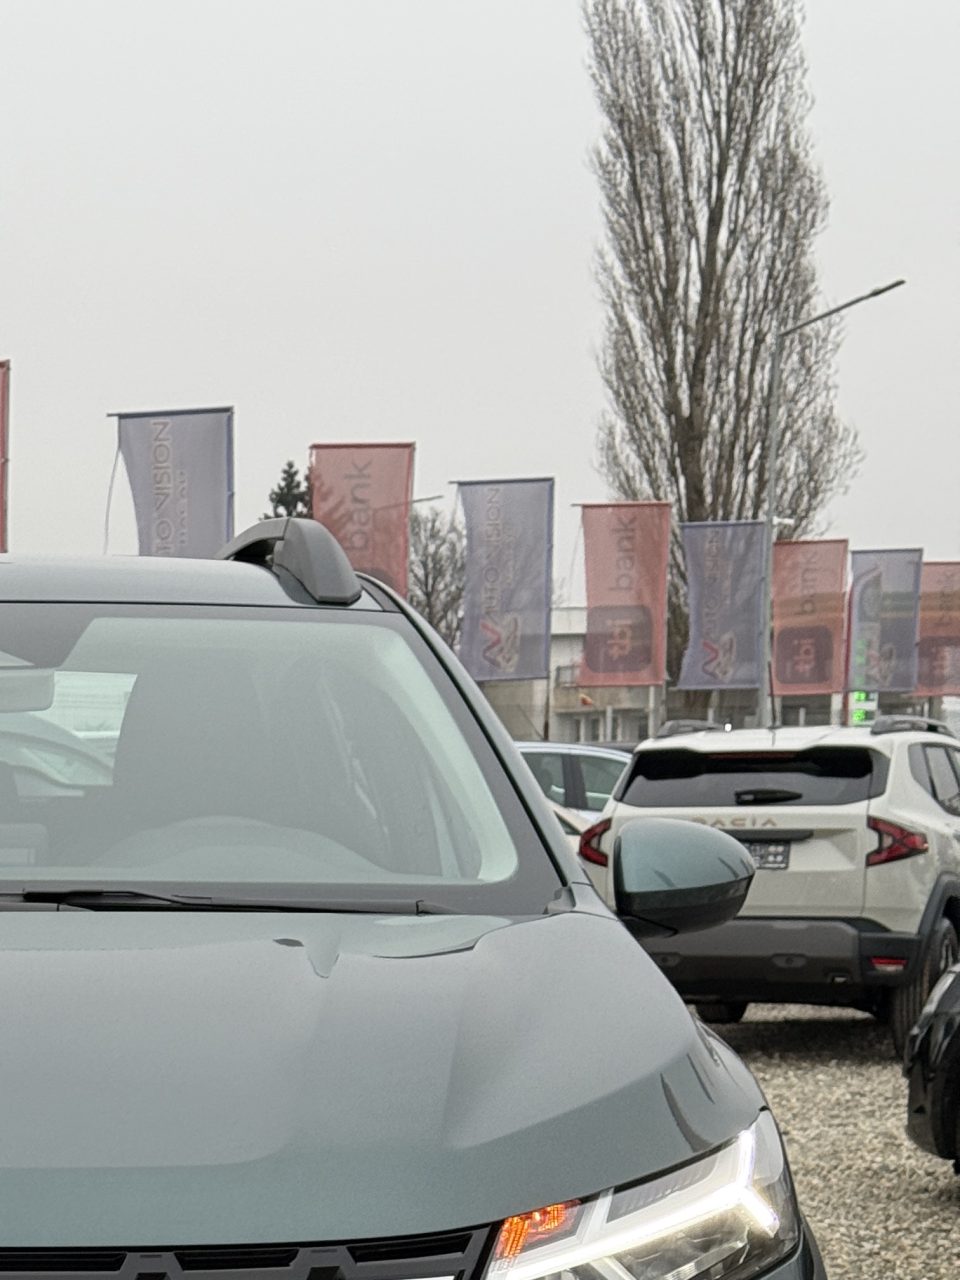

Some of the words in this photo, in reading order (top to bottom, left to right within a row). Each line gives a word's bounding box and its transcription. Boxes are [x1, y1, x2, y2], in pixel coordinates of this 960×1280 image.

[151, 420, 172, 513] VISION
[609, 515, 636, 592] bank
[607, 619, 632, 658] tbi
